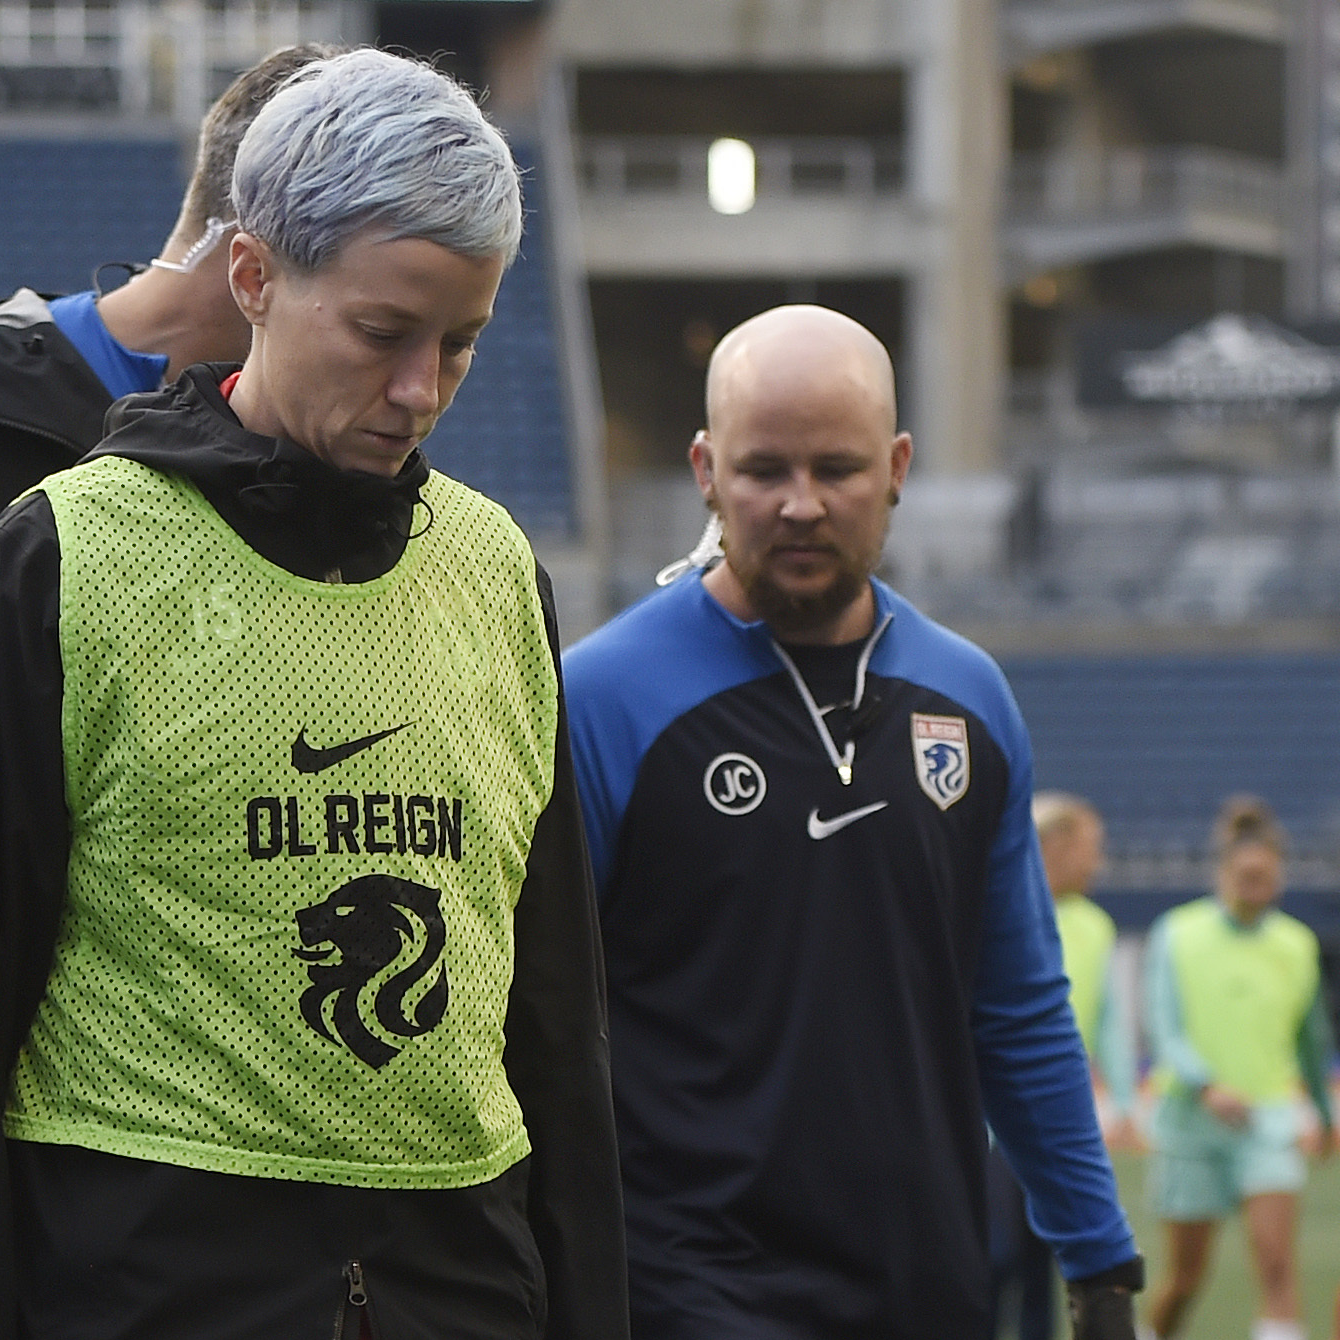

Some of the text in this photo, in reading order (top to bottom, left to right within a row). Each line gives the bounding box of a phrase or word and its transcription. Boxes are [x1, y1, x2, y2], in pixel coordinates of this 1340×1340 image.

[190, 583, 242, 642] 15
[719, 765, 756, 803] JC
[247, 794, 463, 862] OL REIGN
